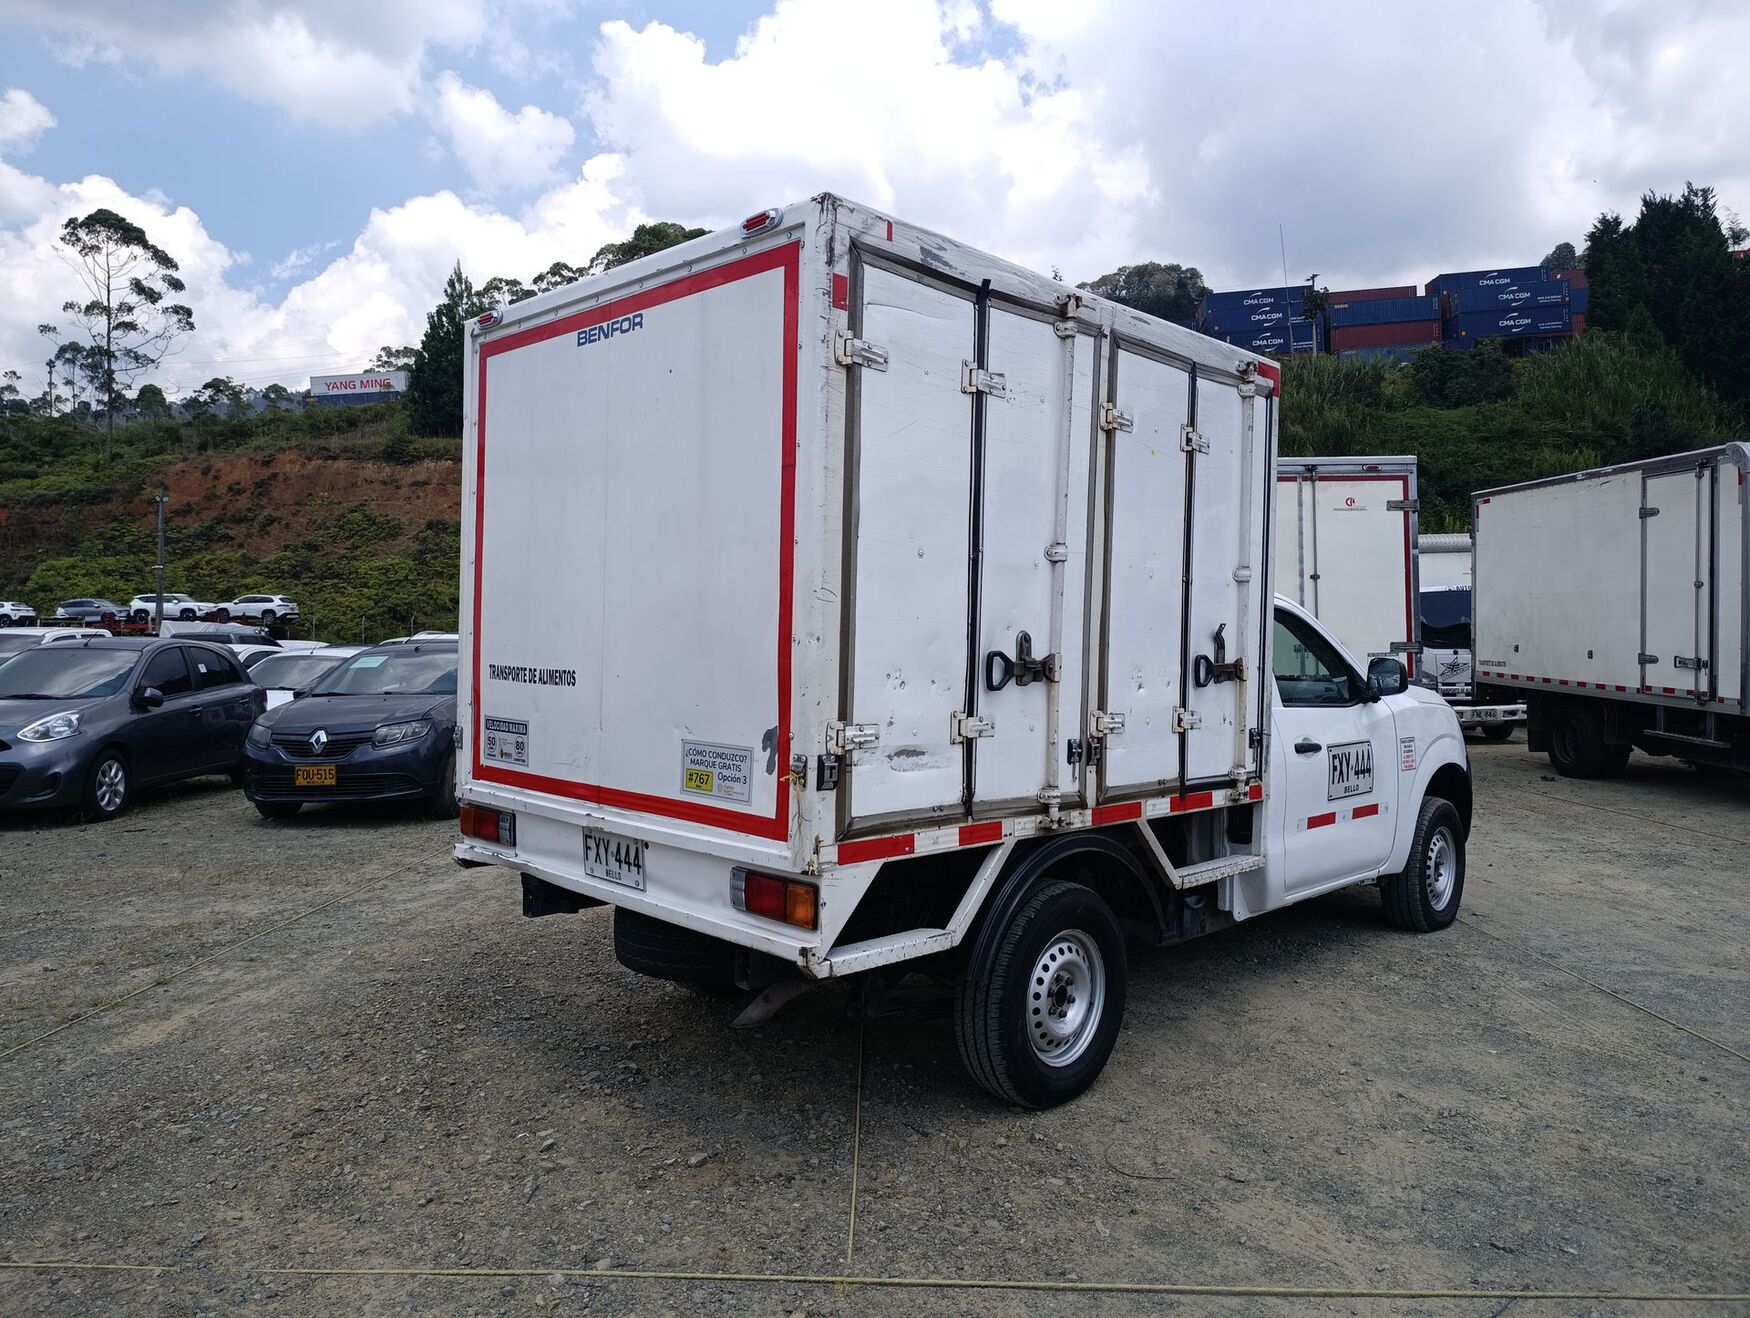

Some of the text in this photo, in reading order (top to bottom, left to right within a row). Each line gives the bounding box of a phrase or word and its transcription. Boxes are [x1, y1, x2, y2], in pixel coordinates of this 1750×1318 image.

[577, 313, 644, 347] BENFOR
[325, 378, 391, 391] YANG MING
[489, 664, 577, 687] TRANSPORTE DE ALIMENTOS
[487, 736, 496, 747] 50
[708, 750, 748, 763] CONDUZCO?
[690, 758, 742, 773] MARQUE GRATIS
[688, 771, 748, 785] #767 Opción 3
[1343, 784, 1360, 794] BELLO
[605, 868, 622, 881] BELLO
